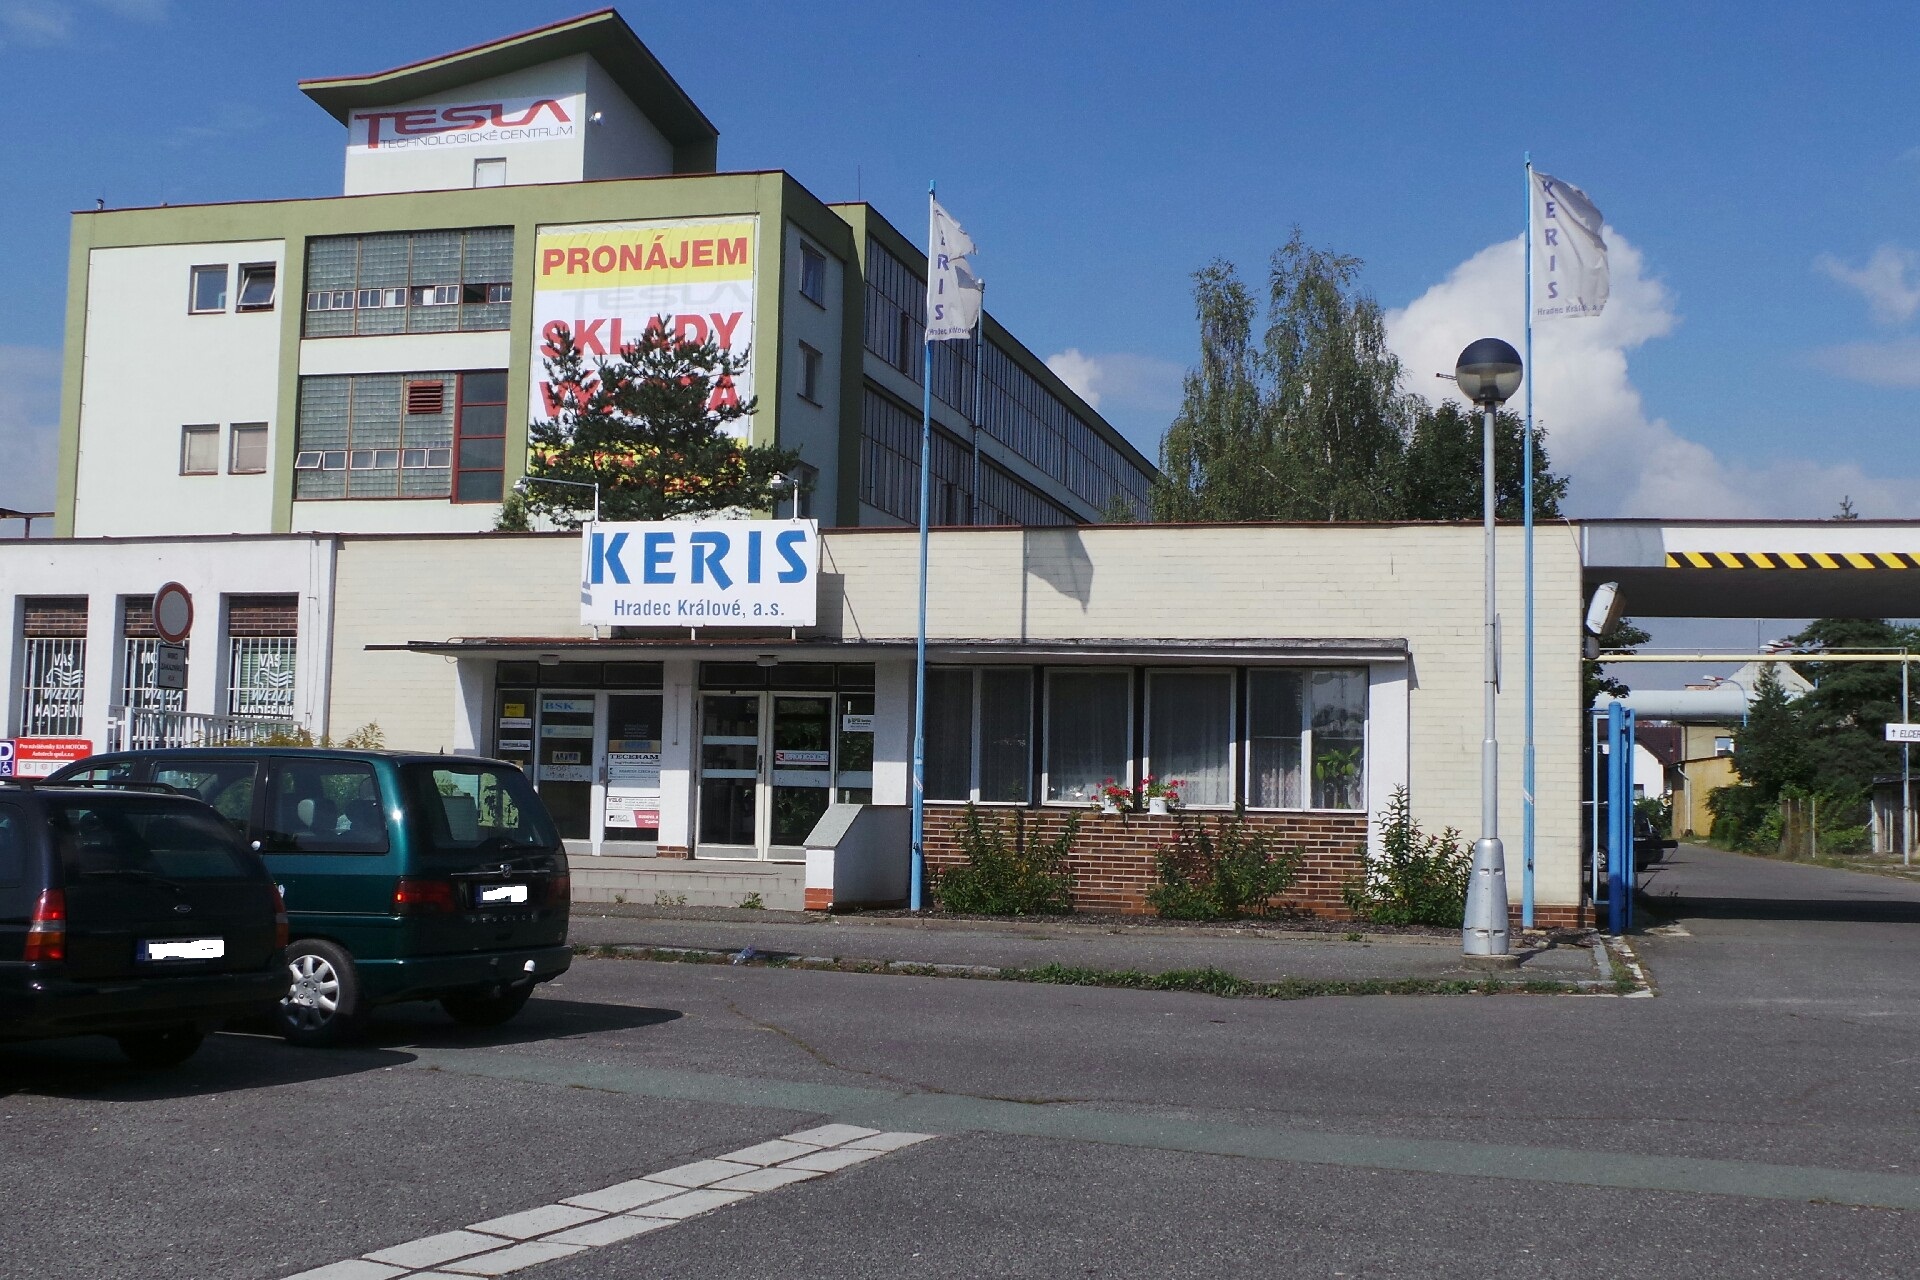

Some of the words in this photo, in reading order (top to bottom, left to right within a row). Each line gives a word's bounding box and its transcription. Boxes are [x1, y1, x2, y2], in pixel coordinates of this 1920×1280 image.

[354, 99, 571, 149] TESLA
[380, 130, 498, 149] TECHNOLOGICKÉ
[501, 126, 573, 140] CENTRUM
[542, 235, 748, 276] PRONÁJEM
[591, 529, 808, 591] KERIS
[614, 599, 671, 616] Hradec
[677, 599, 746, 618] Králové,
[753, 602, 785, 616] a.s.
[545, 702, 574, 710] BSK
